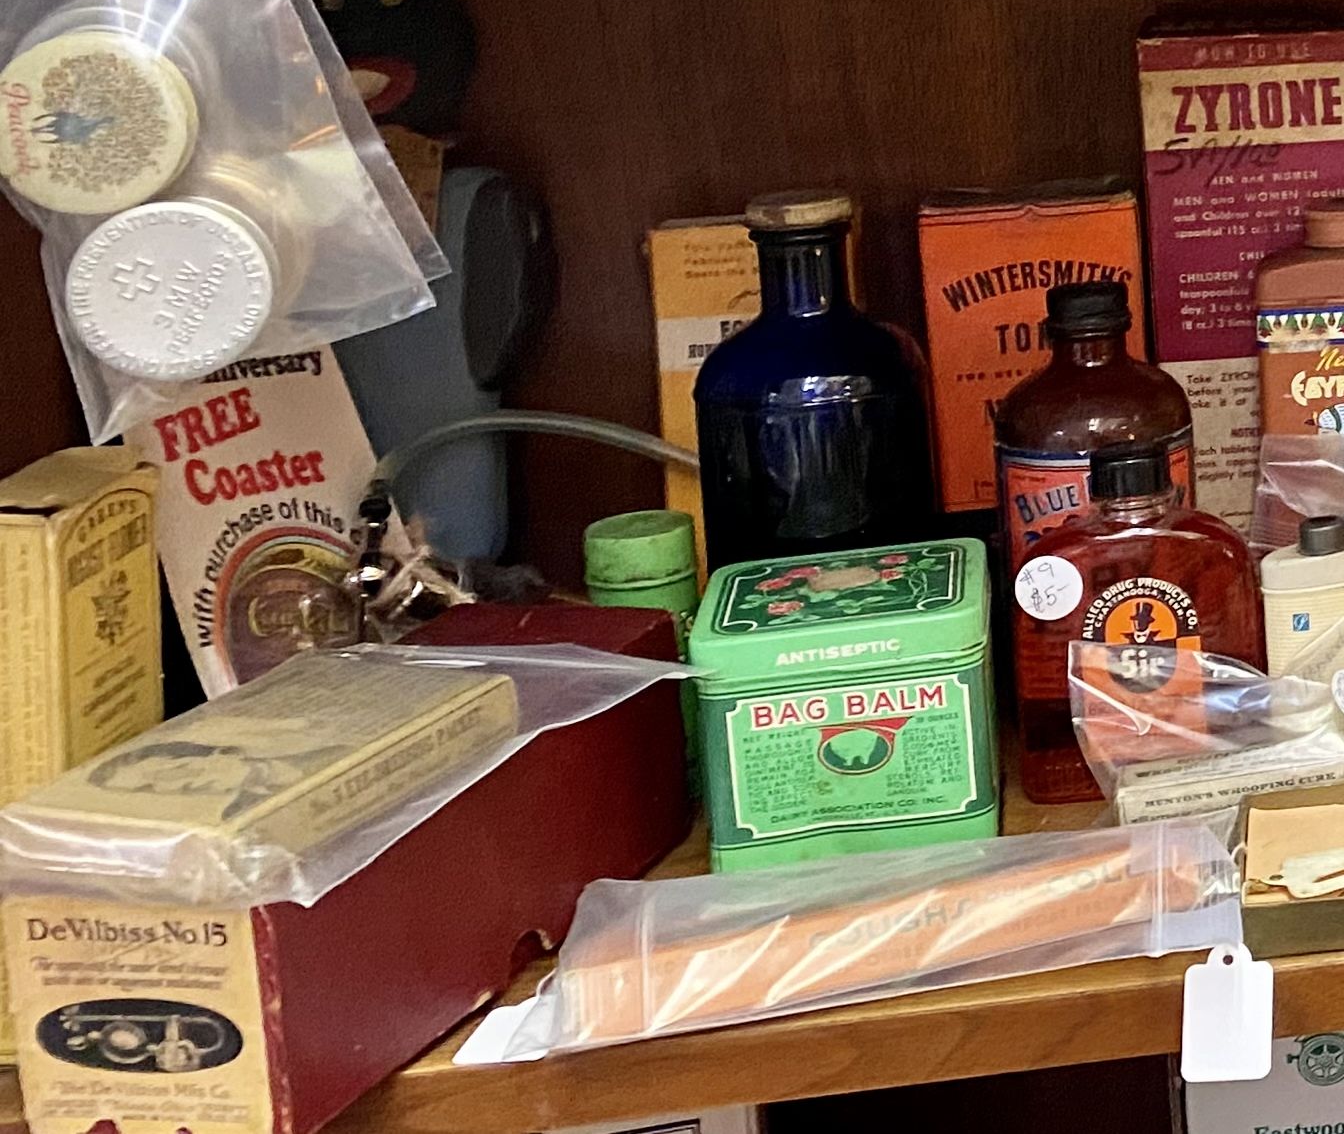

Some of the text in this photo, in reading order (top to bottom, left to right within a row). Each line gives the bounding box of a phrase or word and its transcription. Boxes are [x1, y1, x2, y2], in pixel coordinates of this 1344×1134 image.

[1170, 76, 1344, 135] ZYRONE
[1244, 189, 1300, 204] WOMEN
[942, 259, 1133, 313] WINTERSMITH'S
[1179, 269, 1239, 284] CHILDREN
[153, 387, 262, 463] FREE
[185, 449, 326, 506] Coaster
[1014, 484, 1081, 524] BLUE
[207, 504, 276, 584] purchase
[278, 498, 301, 519] of
[304, 499, 345, 536] this
[1018, 561, 1055, 585] #9
[1082, 596, 1104, 640] ALLIED
[1102, 578, 1135, 601] DRUG
[1136, 576, 1192, 612] PRODUCTS
[775, 638, 902, 668] ANTISEPTIC
[1119, 648, 1165, 680] Sir
[752, 685, 945, 729] BAG BALM
[1216, 771, 1337, 798] WHOOPING CURE
[27, 916, 156, 943] DeVilbiss
[203, 922, 228, 947] 15
